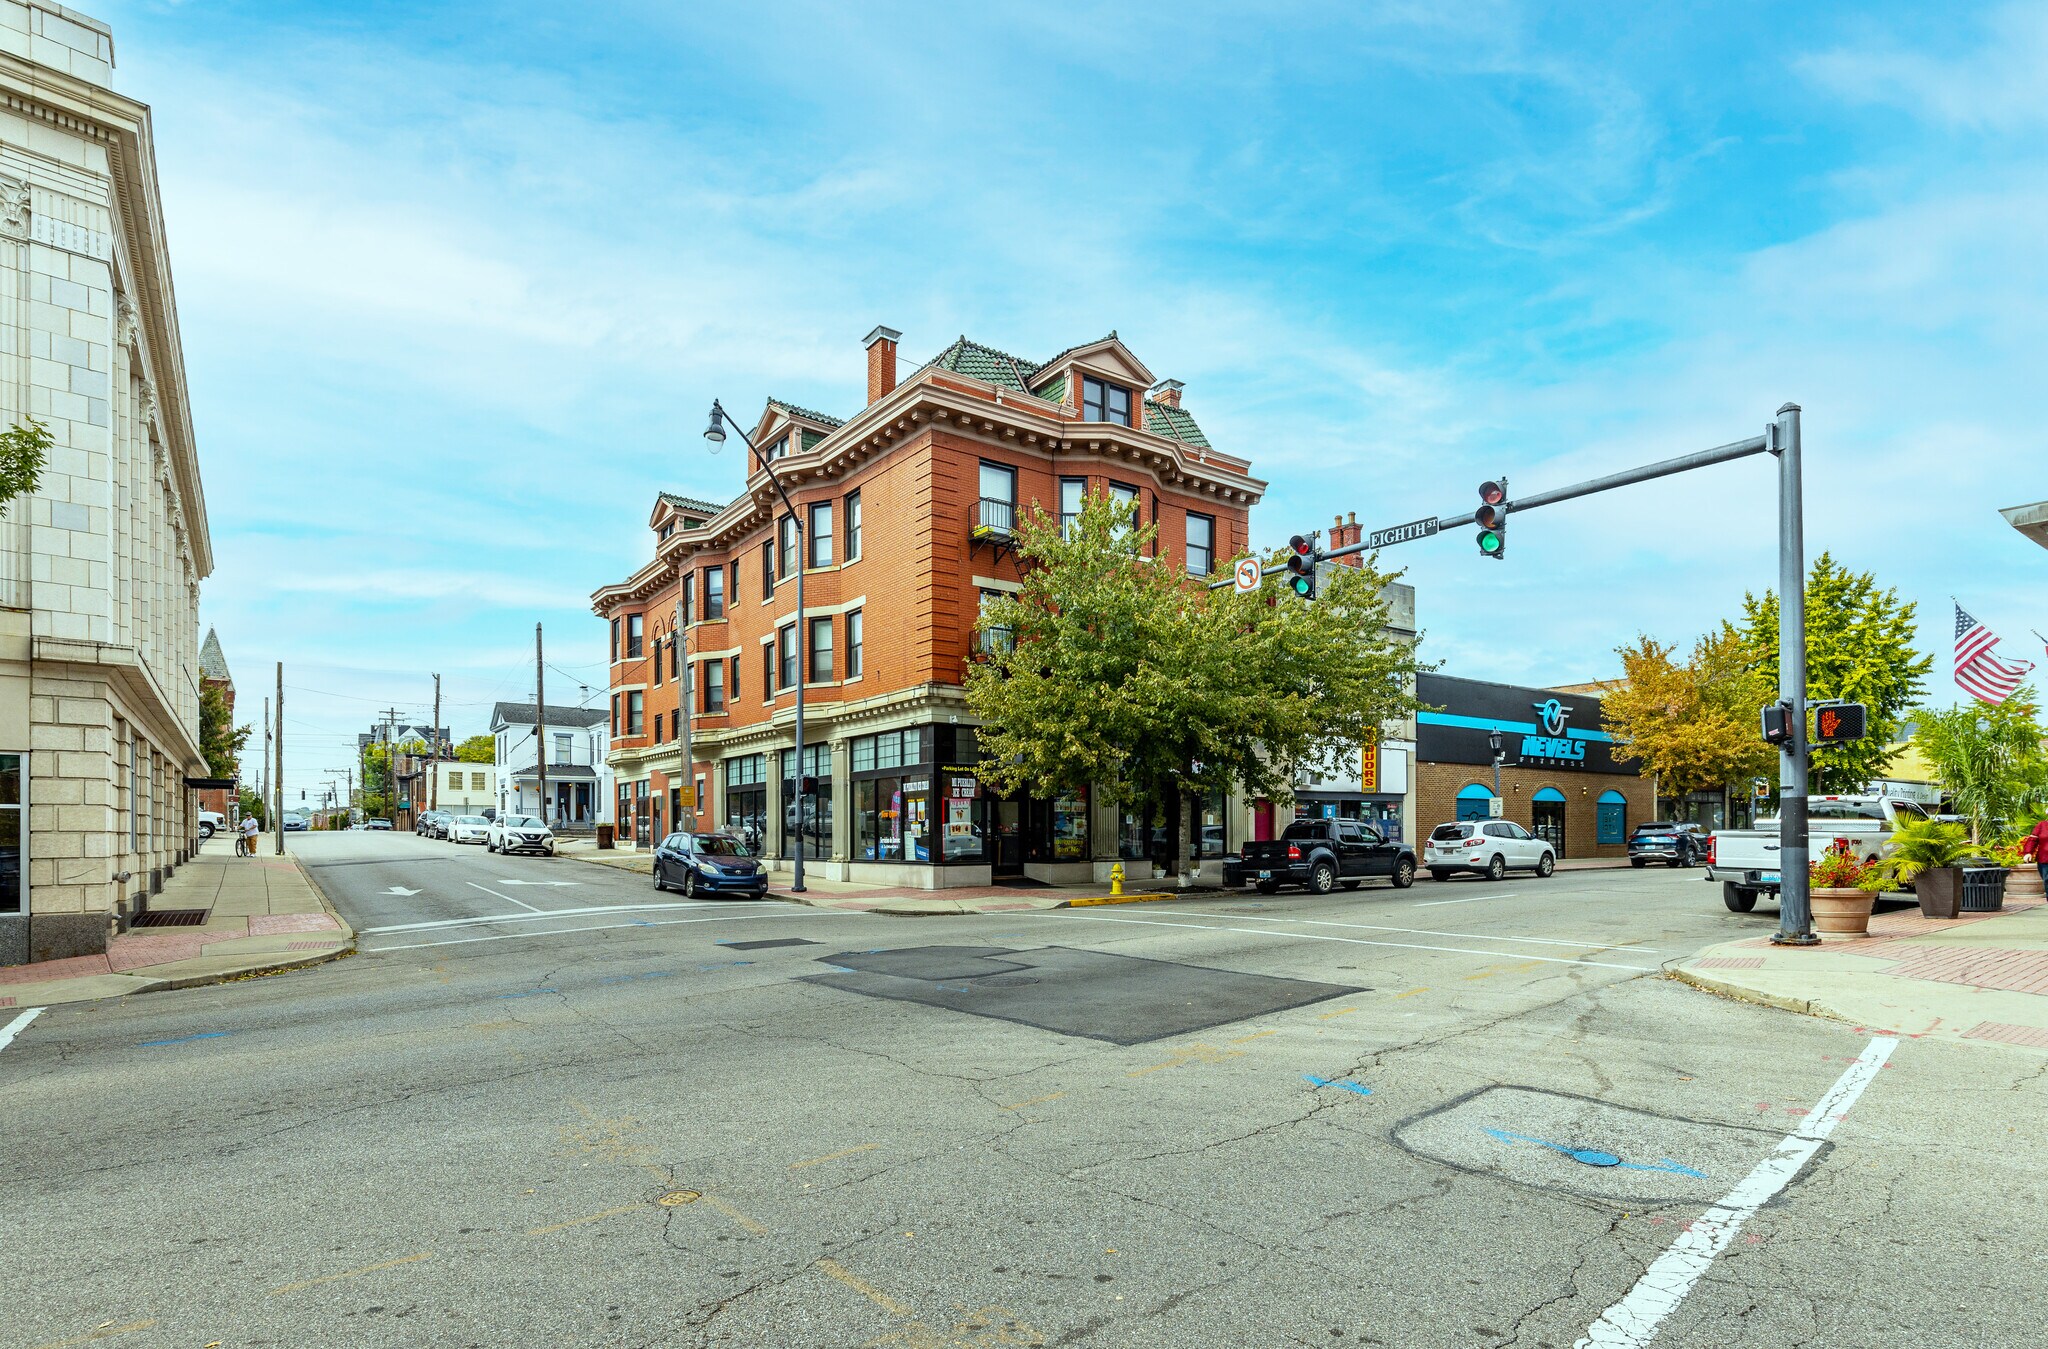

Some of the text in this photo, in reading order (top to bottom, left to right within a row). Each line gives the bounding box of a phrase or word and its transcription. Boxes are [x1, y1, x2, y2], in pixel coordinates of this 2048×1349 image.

[1371, 519, 1437, 547] EIGHTH ST
[1521, 735, 1586, 760] NEVELS
[1519, 756, 1585, 767] FITNESS
